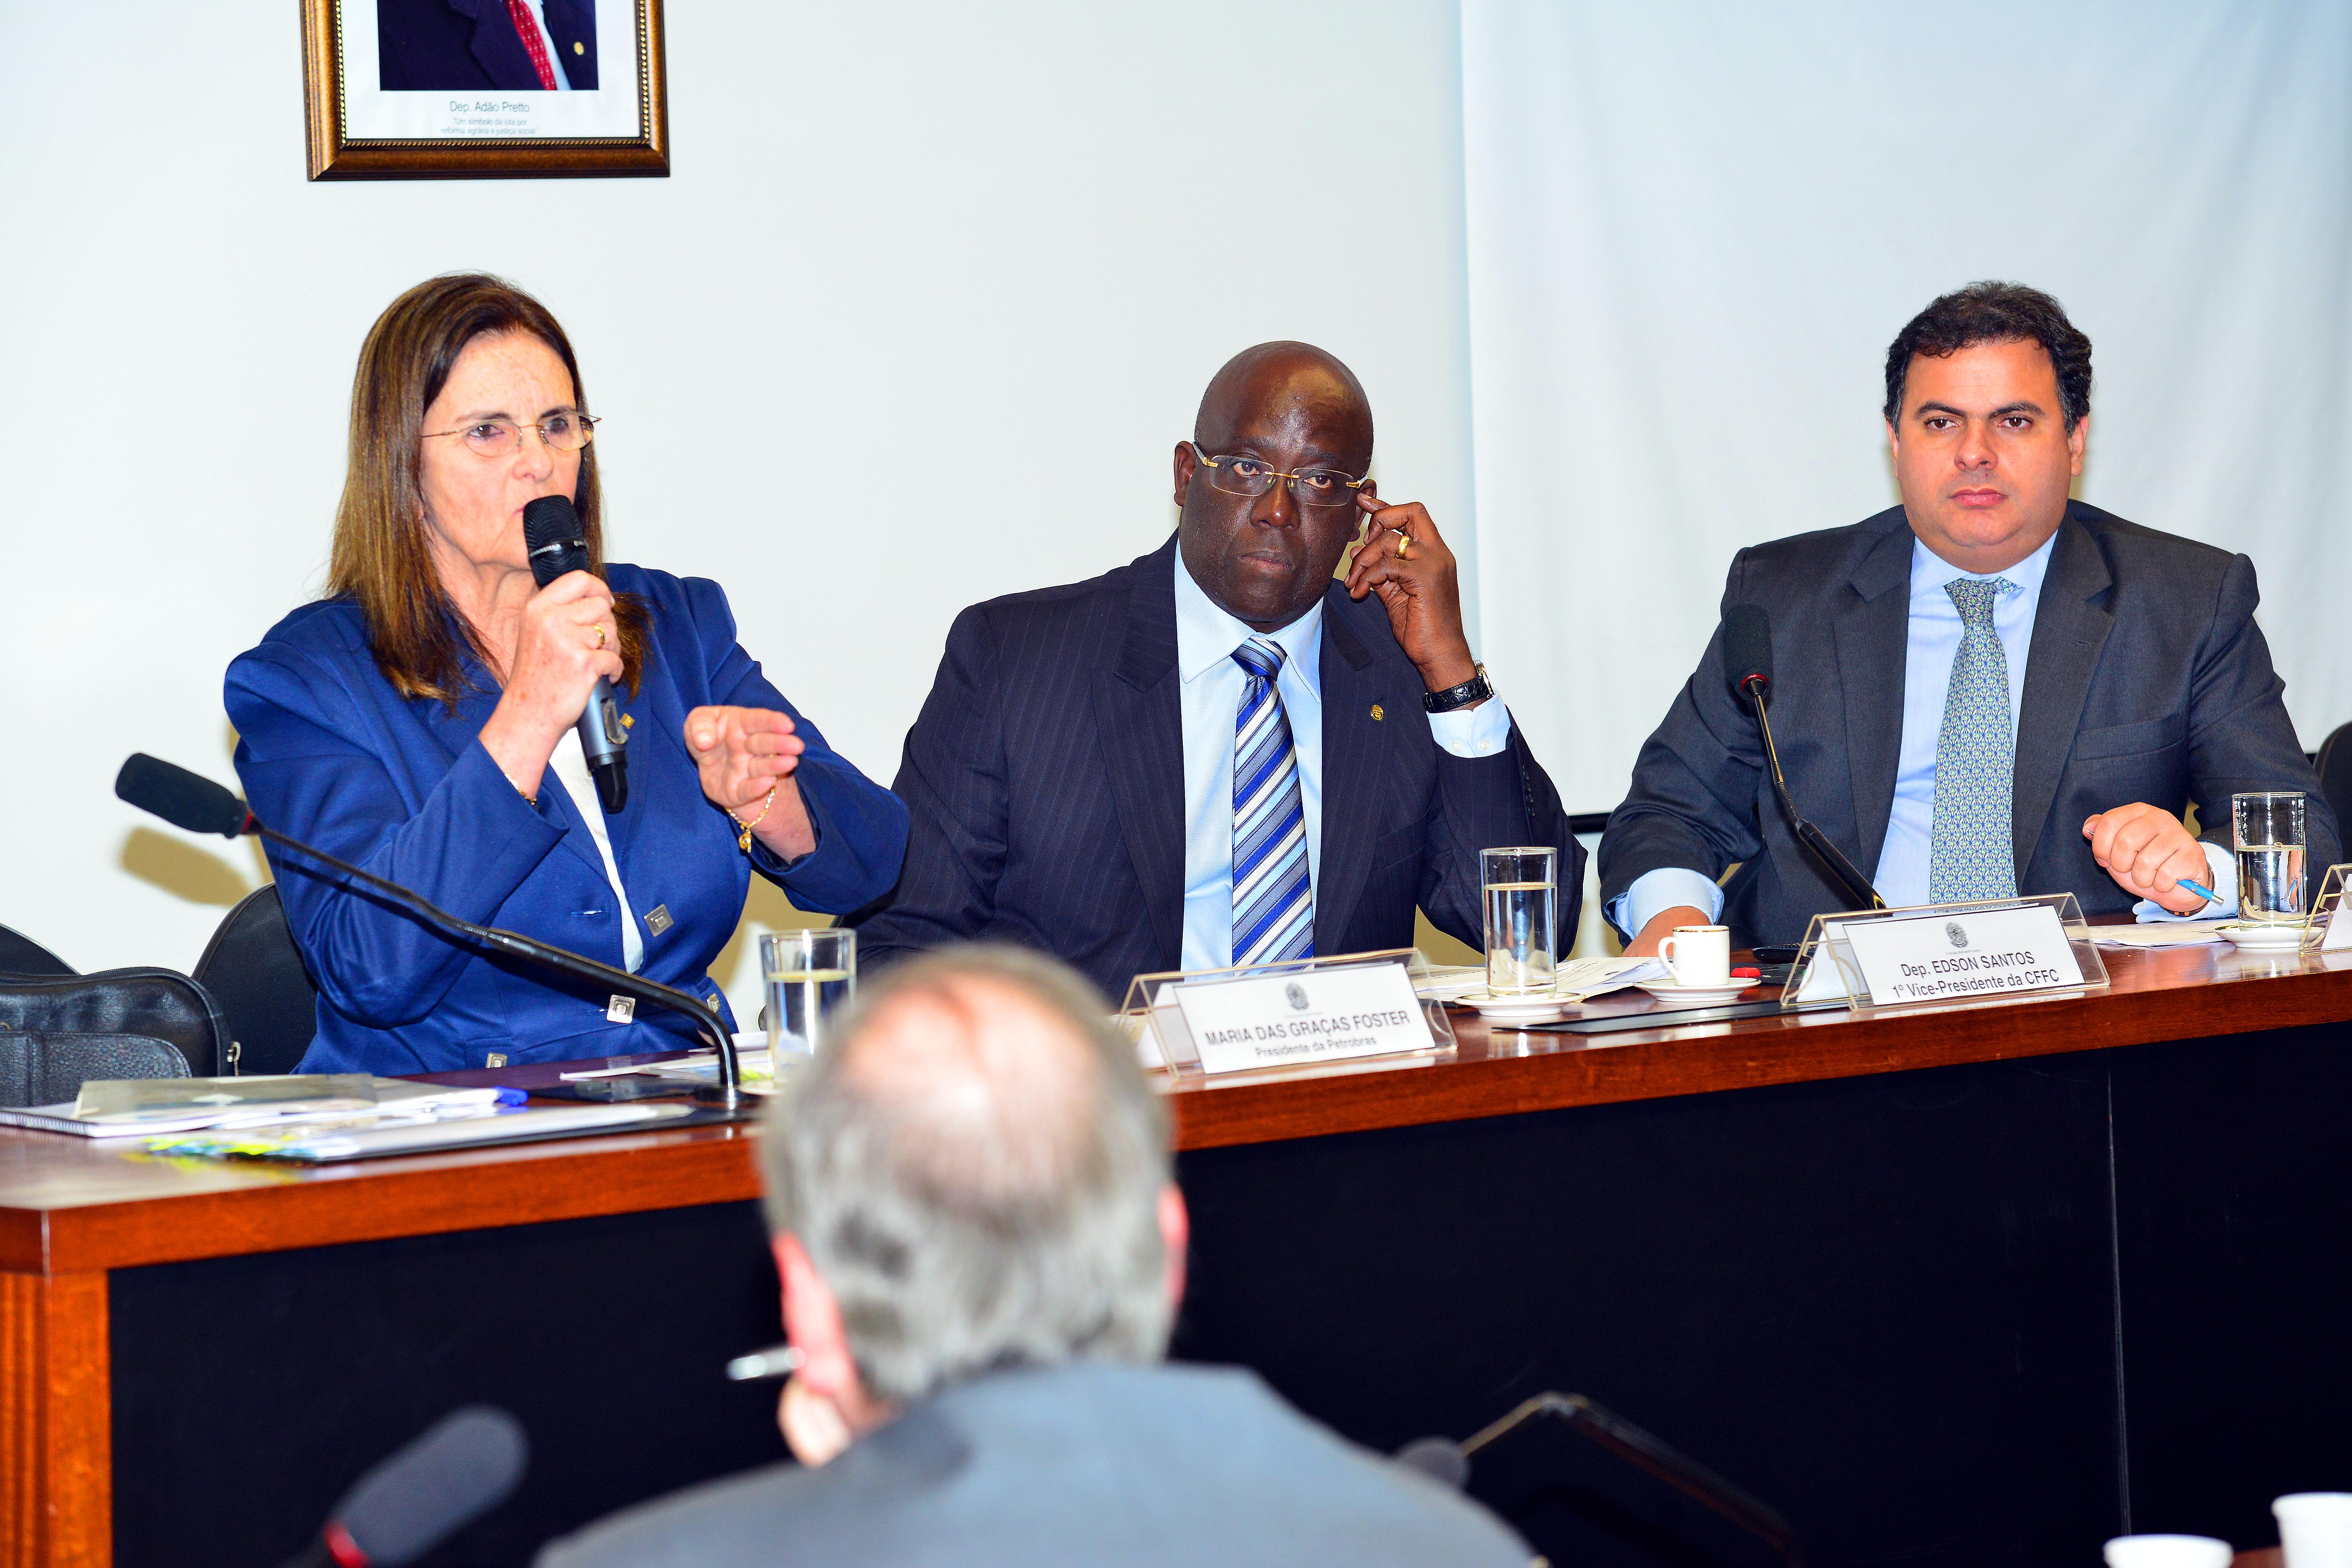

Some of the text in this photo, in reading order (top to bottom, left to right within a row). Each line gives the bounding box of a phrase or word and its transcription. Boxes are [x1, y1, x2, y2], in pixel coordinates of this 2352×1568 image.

[450, 101, 530, 114] Dep. Adão Pretto
[1900, 964, 1931, 979] Dep.
[1931, 957, 1980, 973] EDSON
[1980, 951, 2035, 968] SANTOS
[1906, 976, 2005, 997] Vice-Presidente
[2007, 973, 2023, 986] da
[2025, 969, 2059, 984] CFFC
[1205, 1010, 1411, 1044] MARIA DAS GRAÇAS FOSTER
[1255, 1037, 1377, 1056] Presidente da Petrobras
